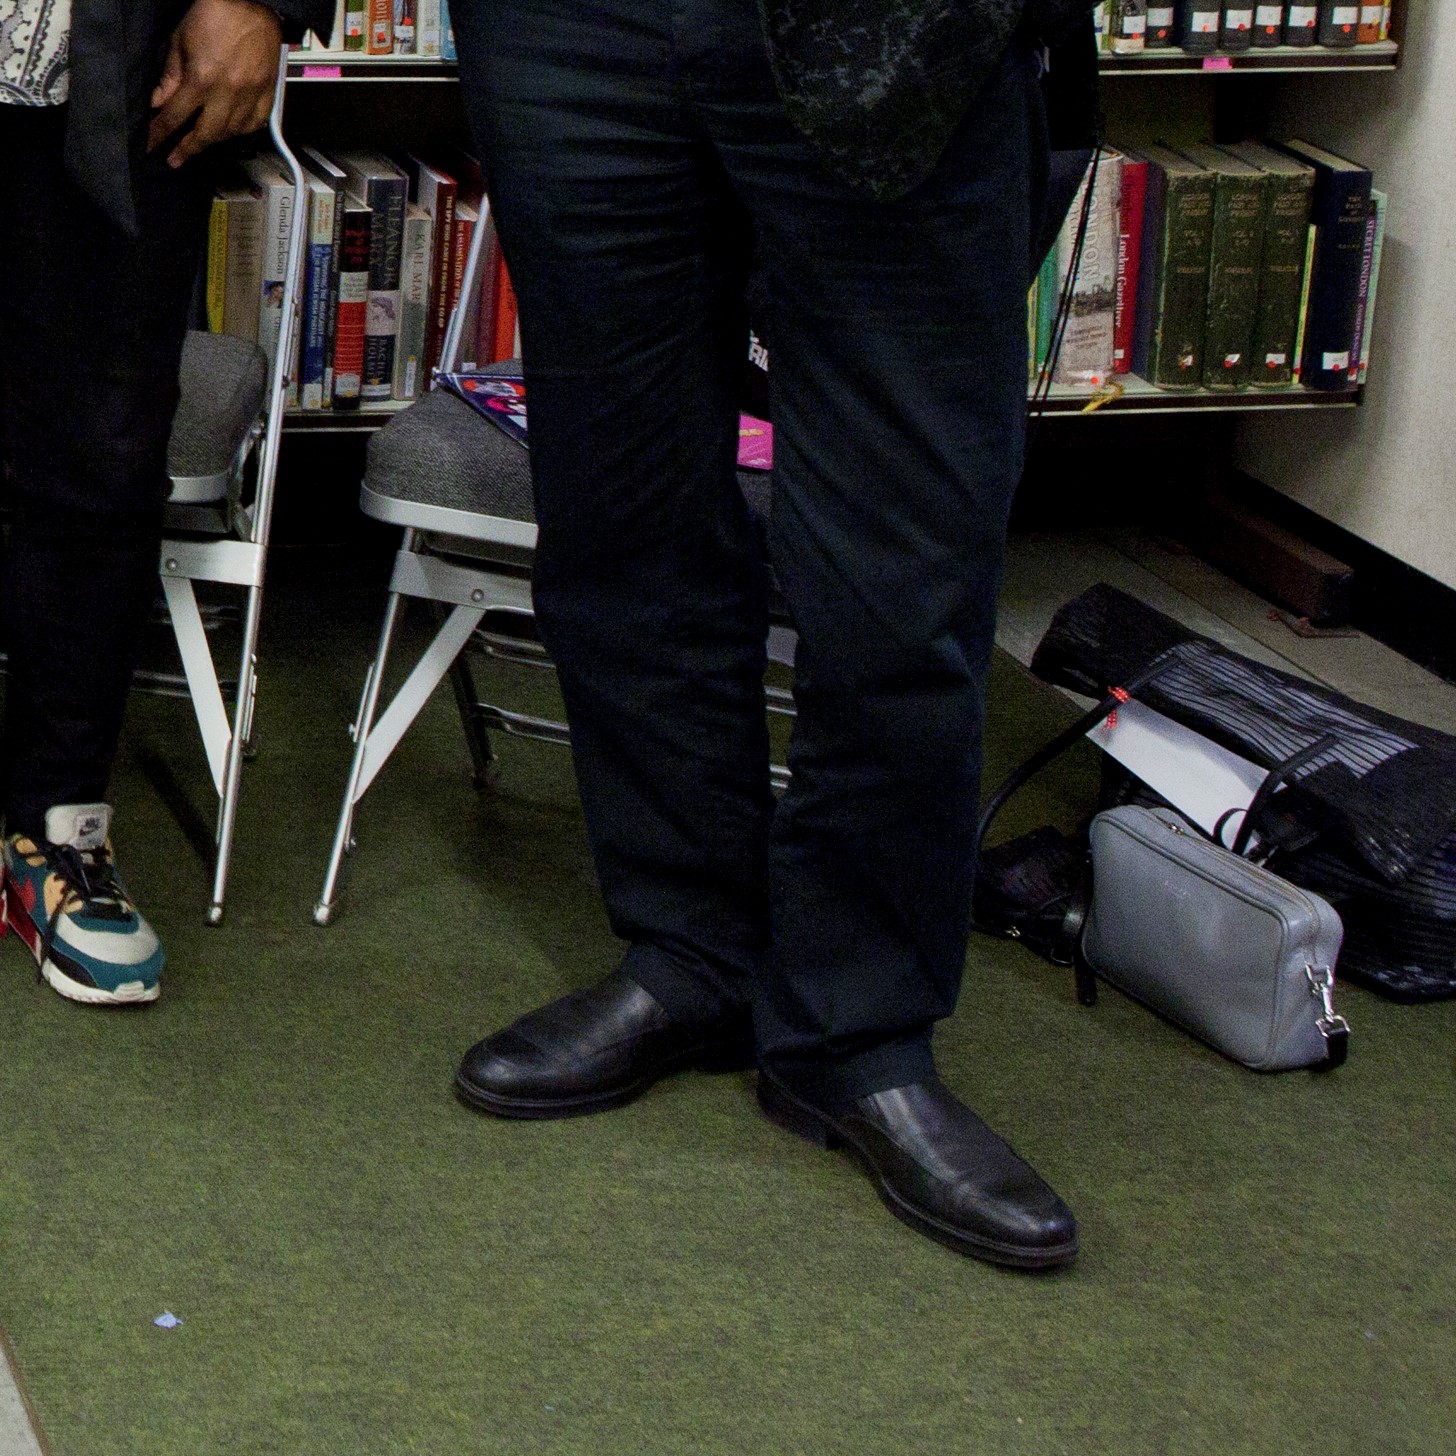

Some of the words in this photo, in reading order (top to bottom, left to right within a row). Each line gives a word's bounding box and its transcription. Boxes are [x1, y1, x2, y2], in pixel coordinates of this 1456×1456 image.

[278, 196, 290, 233] Glenda
[276, 236, 288, 274] Jackson
[385, 196, 402, 285] ELEANOR
[414, 233, 424, 264] KARL
[1118, 233, 1130, 274] London
[1359, 254, 1372, 298] LONDON
